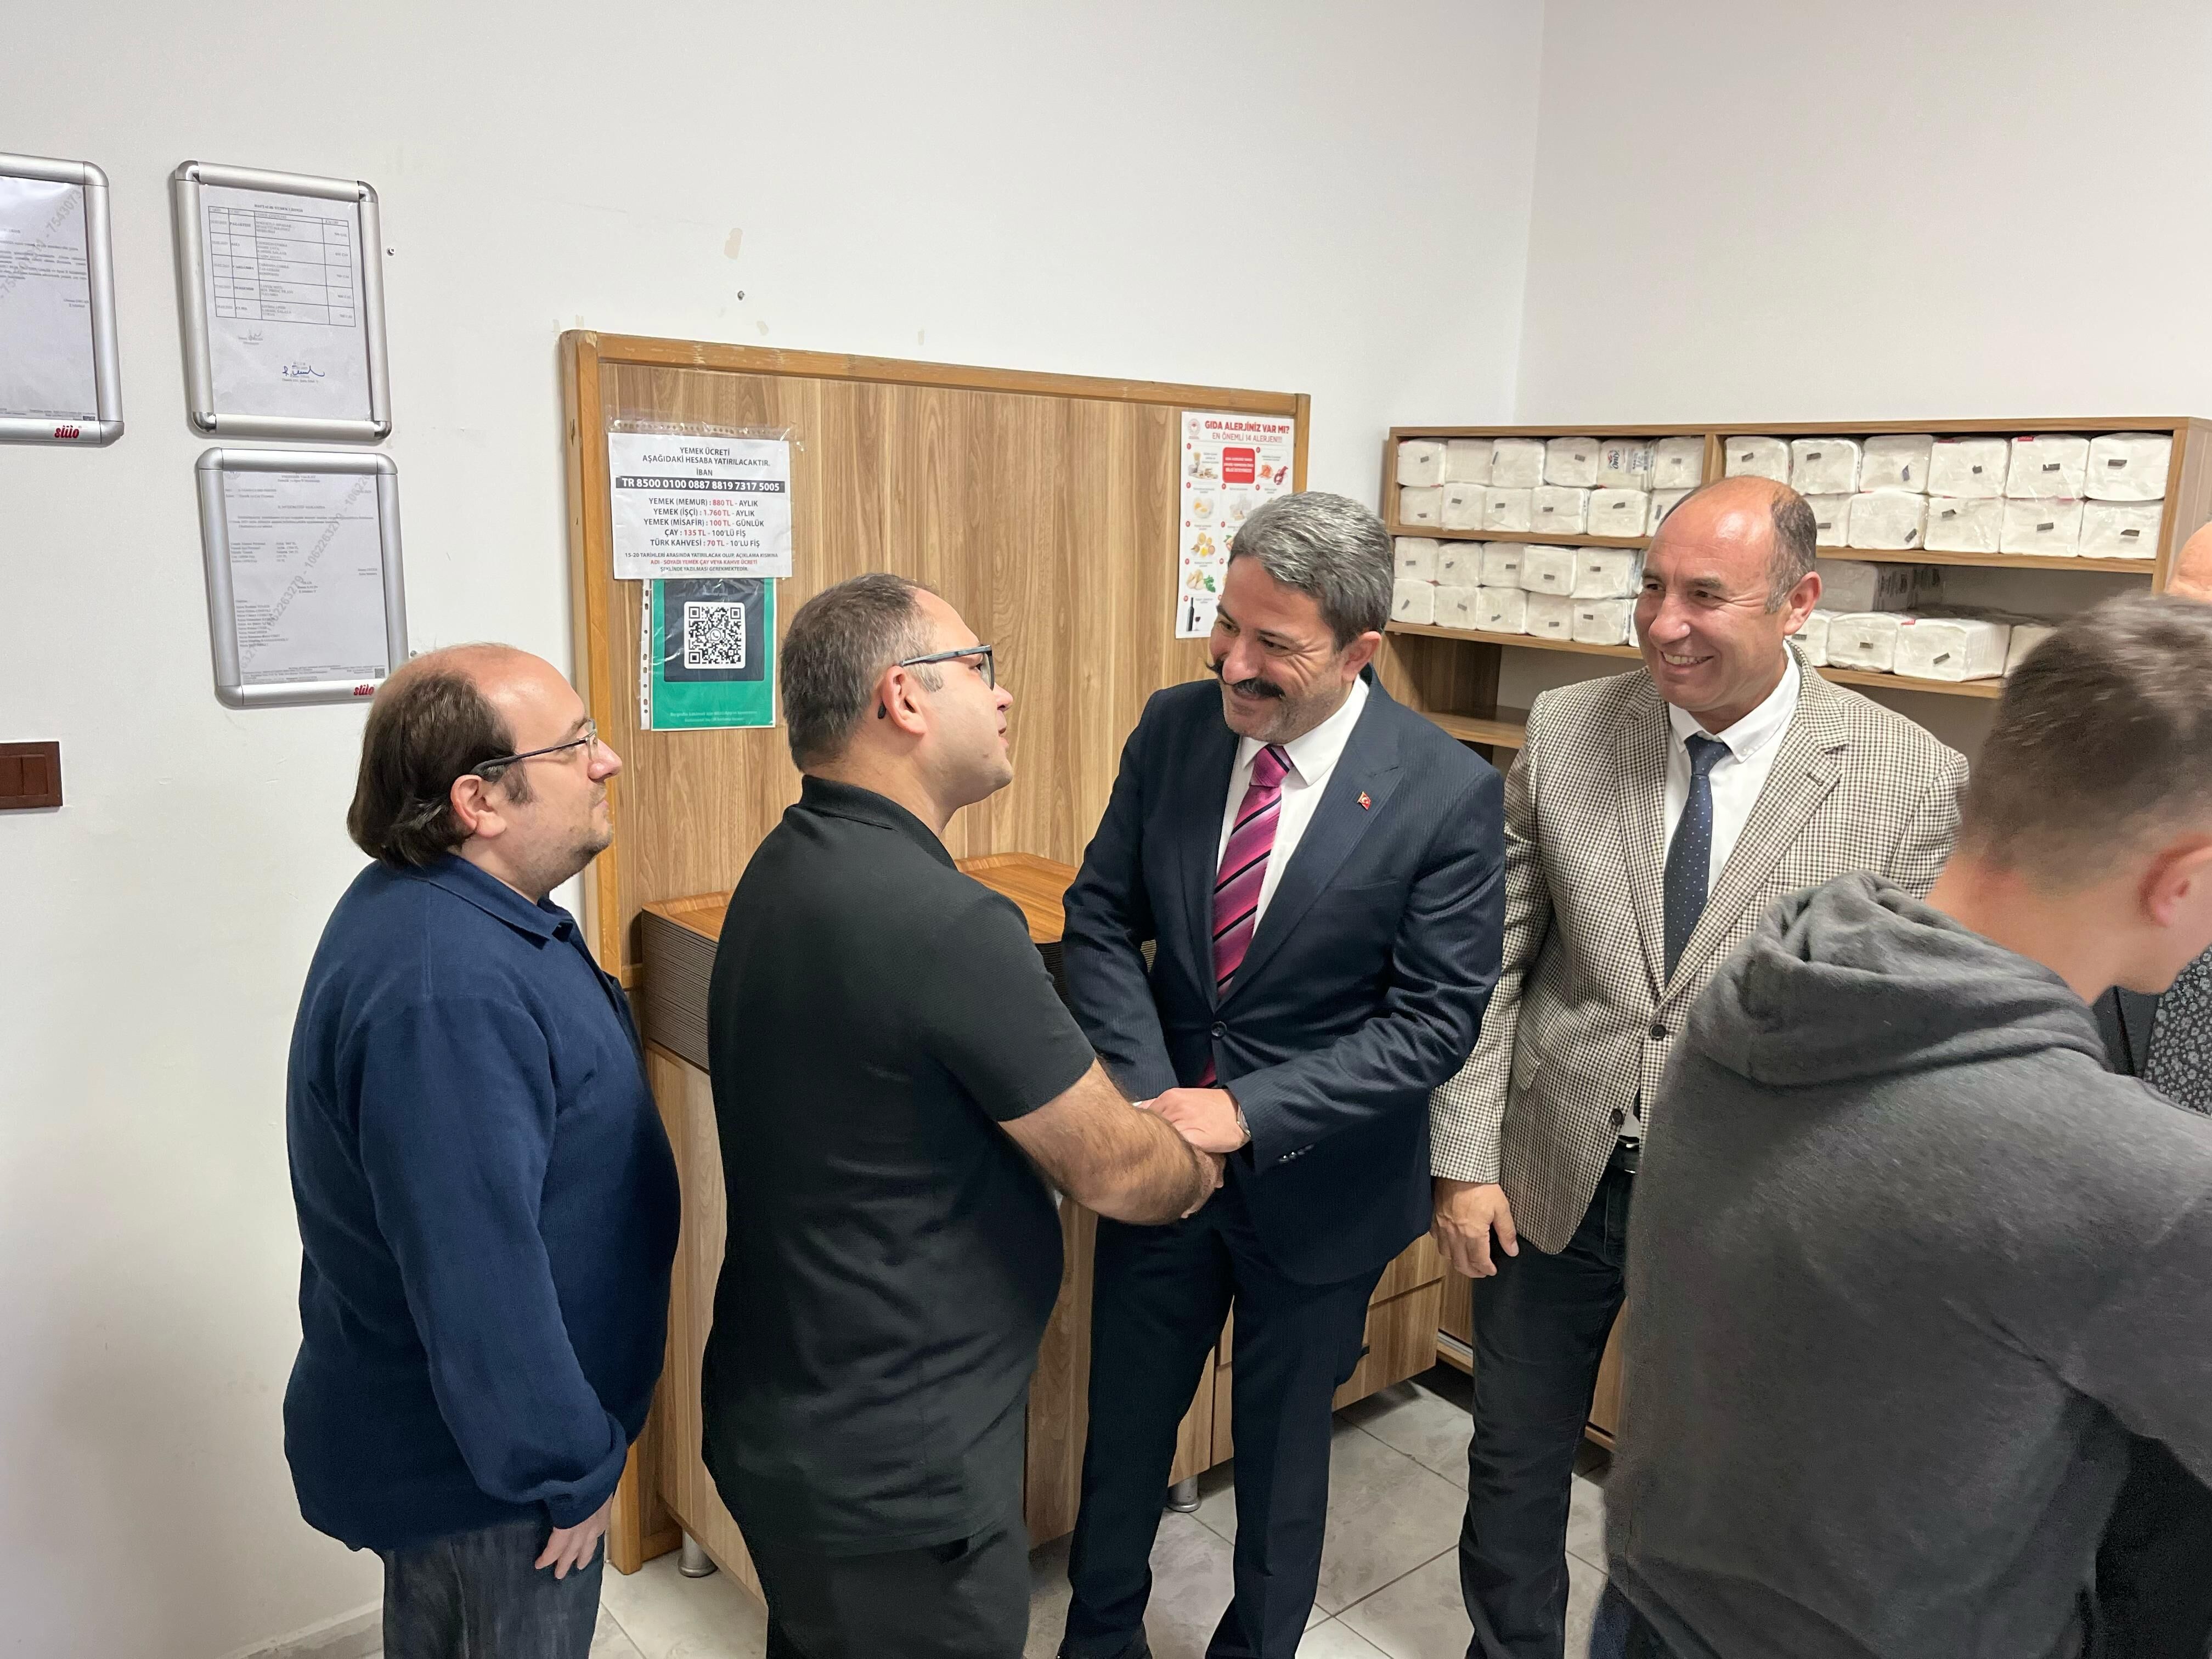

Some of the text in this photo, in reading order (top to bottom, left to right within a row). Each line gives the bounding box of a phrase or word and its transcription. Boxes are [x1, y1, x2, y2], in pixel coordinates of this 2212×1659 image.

[1205, 421, 1290, 434] GIDA ALERJİNİZ VAR MI?
[1222, 431, 1244, 441] ÖNEMLİ
[706, 447, 730, 455] ÜCRETİ
[643, 454, 684, 463] AŞAĞIDAKİ
[714, 458, 770, 466] YATIRILACAKTIR.
[622, 478, 634, 487] TR
[636, 479, 661, 487] 8500
[663, 479, 686, 488] 0100
[689, 480, 709, 489] 0887
[712, 481, 733, 489] 8819
[759, 483, 779, 491] 5005
[680, 508, 697, 517] (İŞÇİ)
[671, 518, 704, 527] (MİSAFİR)
[736, 529, 746, 538] FİŞ
[751, 540, 760, 548] FİŞ
